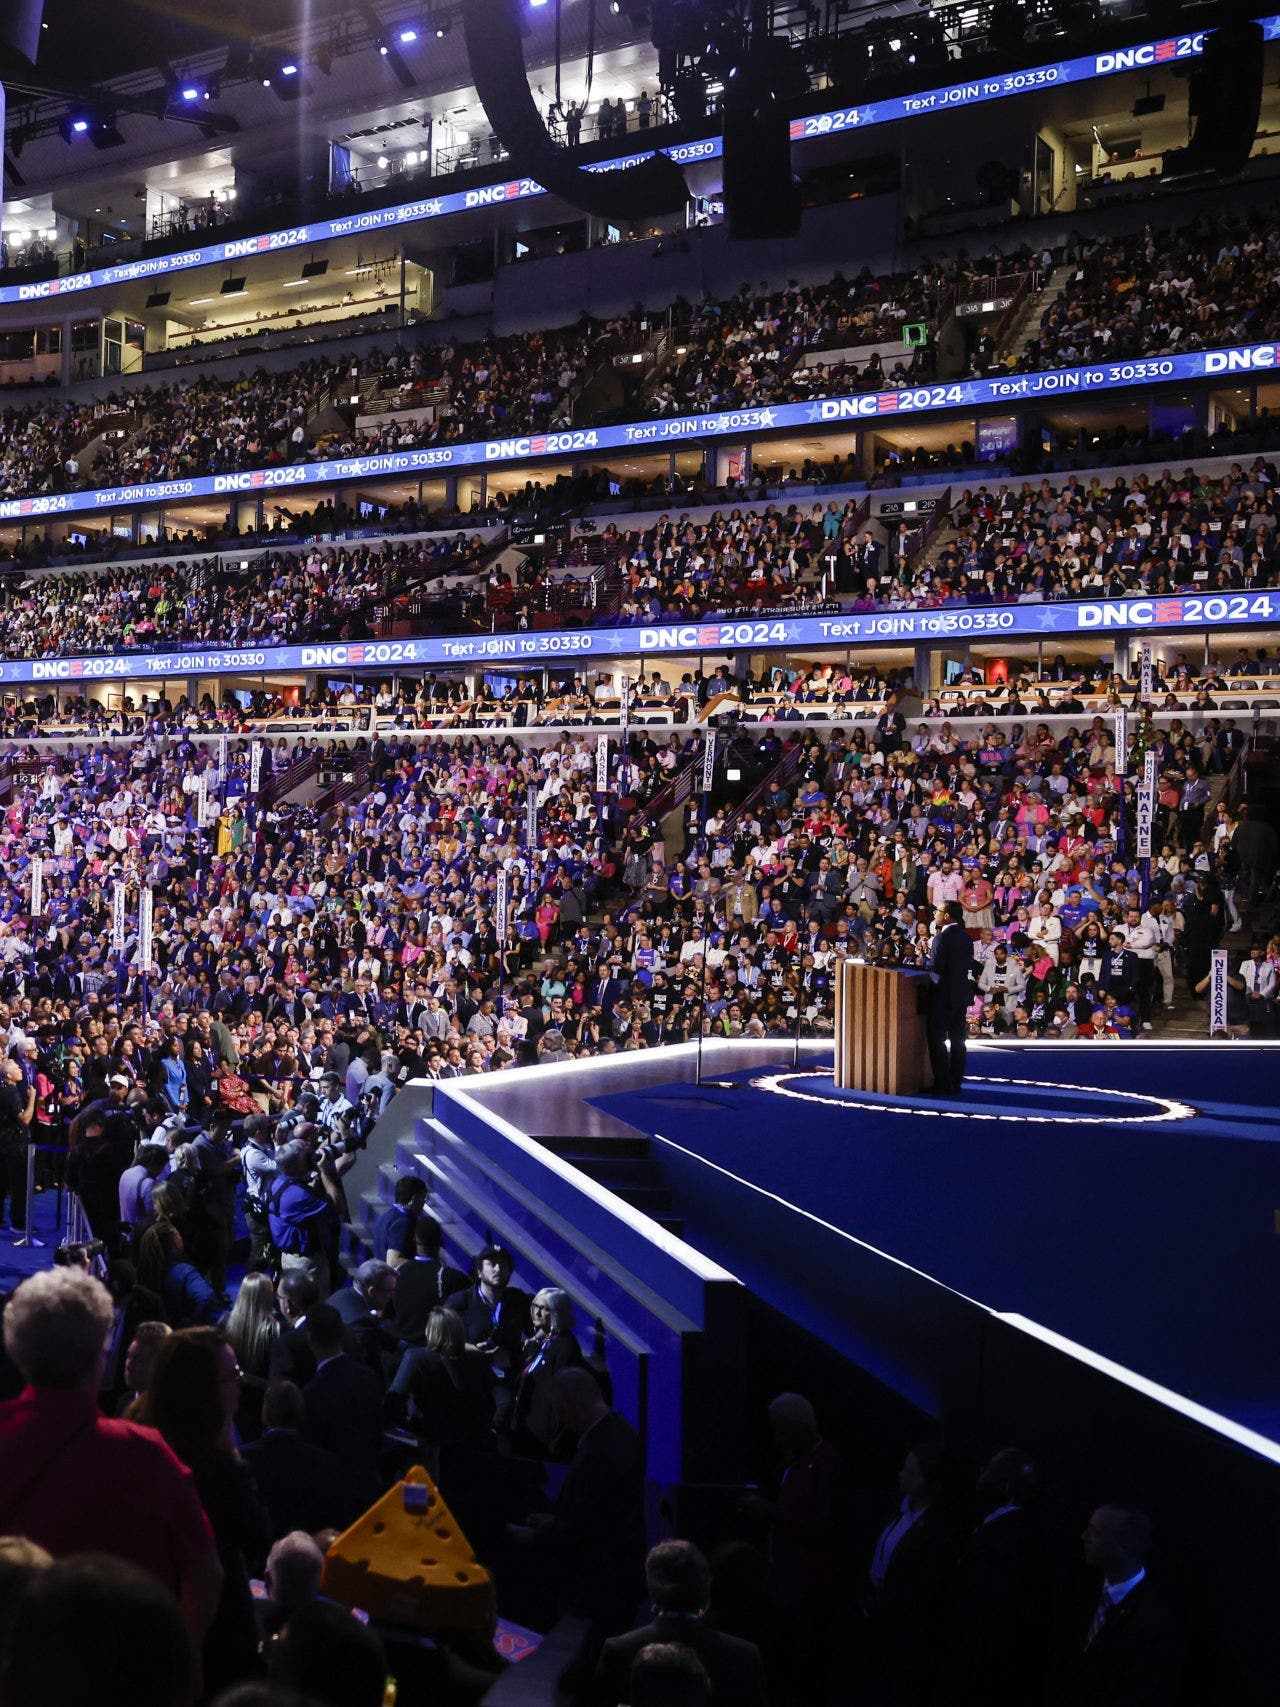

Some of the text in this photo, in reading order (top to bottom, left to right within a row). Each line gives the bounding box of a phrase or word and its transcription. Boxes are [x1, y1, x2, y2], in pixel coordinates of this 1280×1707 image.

[902, 68, 1058, 112] Text JOIN to 30330
[669, 142, 714, 161] 30330
[465, 185, 505, 207] DNC
[224, 227, 307, 258] DNC 2024
[20, 282, 50, 300] DNC
[59, 273, 92, 292] 2024
[1205, 345, 1275, 373] DNC
[989, 360, 1173, 396] Text JOIN to 30330
[821, 385, 963, 419] DNC 2024
[485, 430, 598, 459] DNC 2024
[214, 466, 306, 492] DNC 2024
[31, 495, 67, 514] 2024
[820, 612, 1014, 636] Text JOIN to 30330
[1077, 595, 1273, 627] DNC 2024
[639, 622, 788, 650] DNC 2024
[32, 657, 126, 677] DNC 2024
[301, 642, 417, 665] DNC 2024
[1143, 647, 1151, 695] HAWAII
[706, 738, 714, 783] VERMONT
[1139, 791, 1150, 848] MAINE
[1214, 959, 1224, 1025] NEBRASKA
